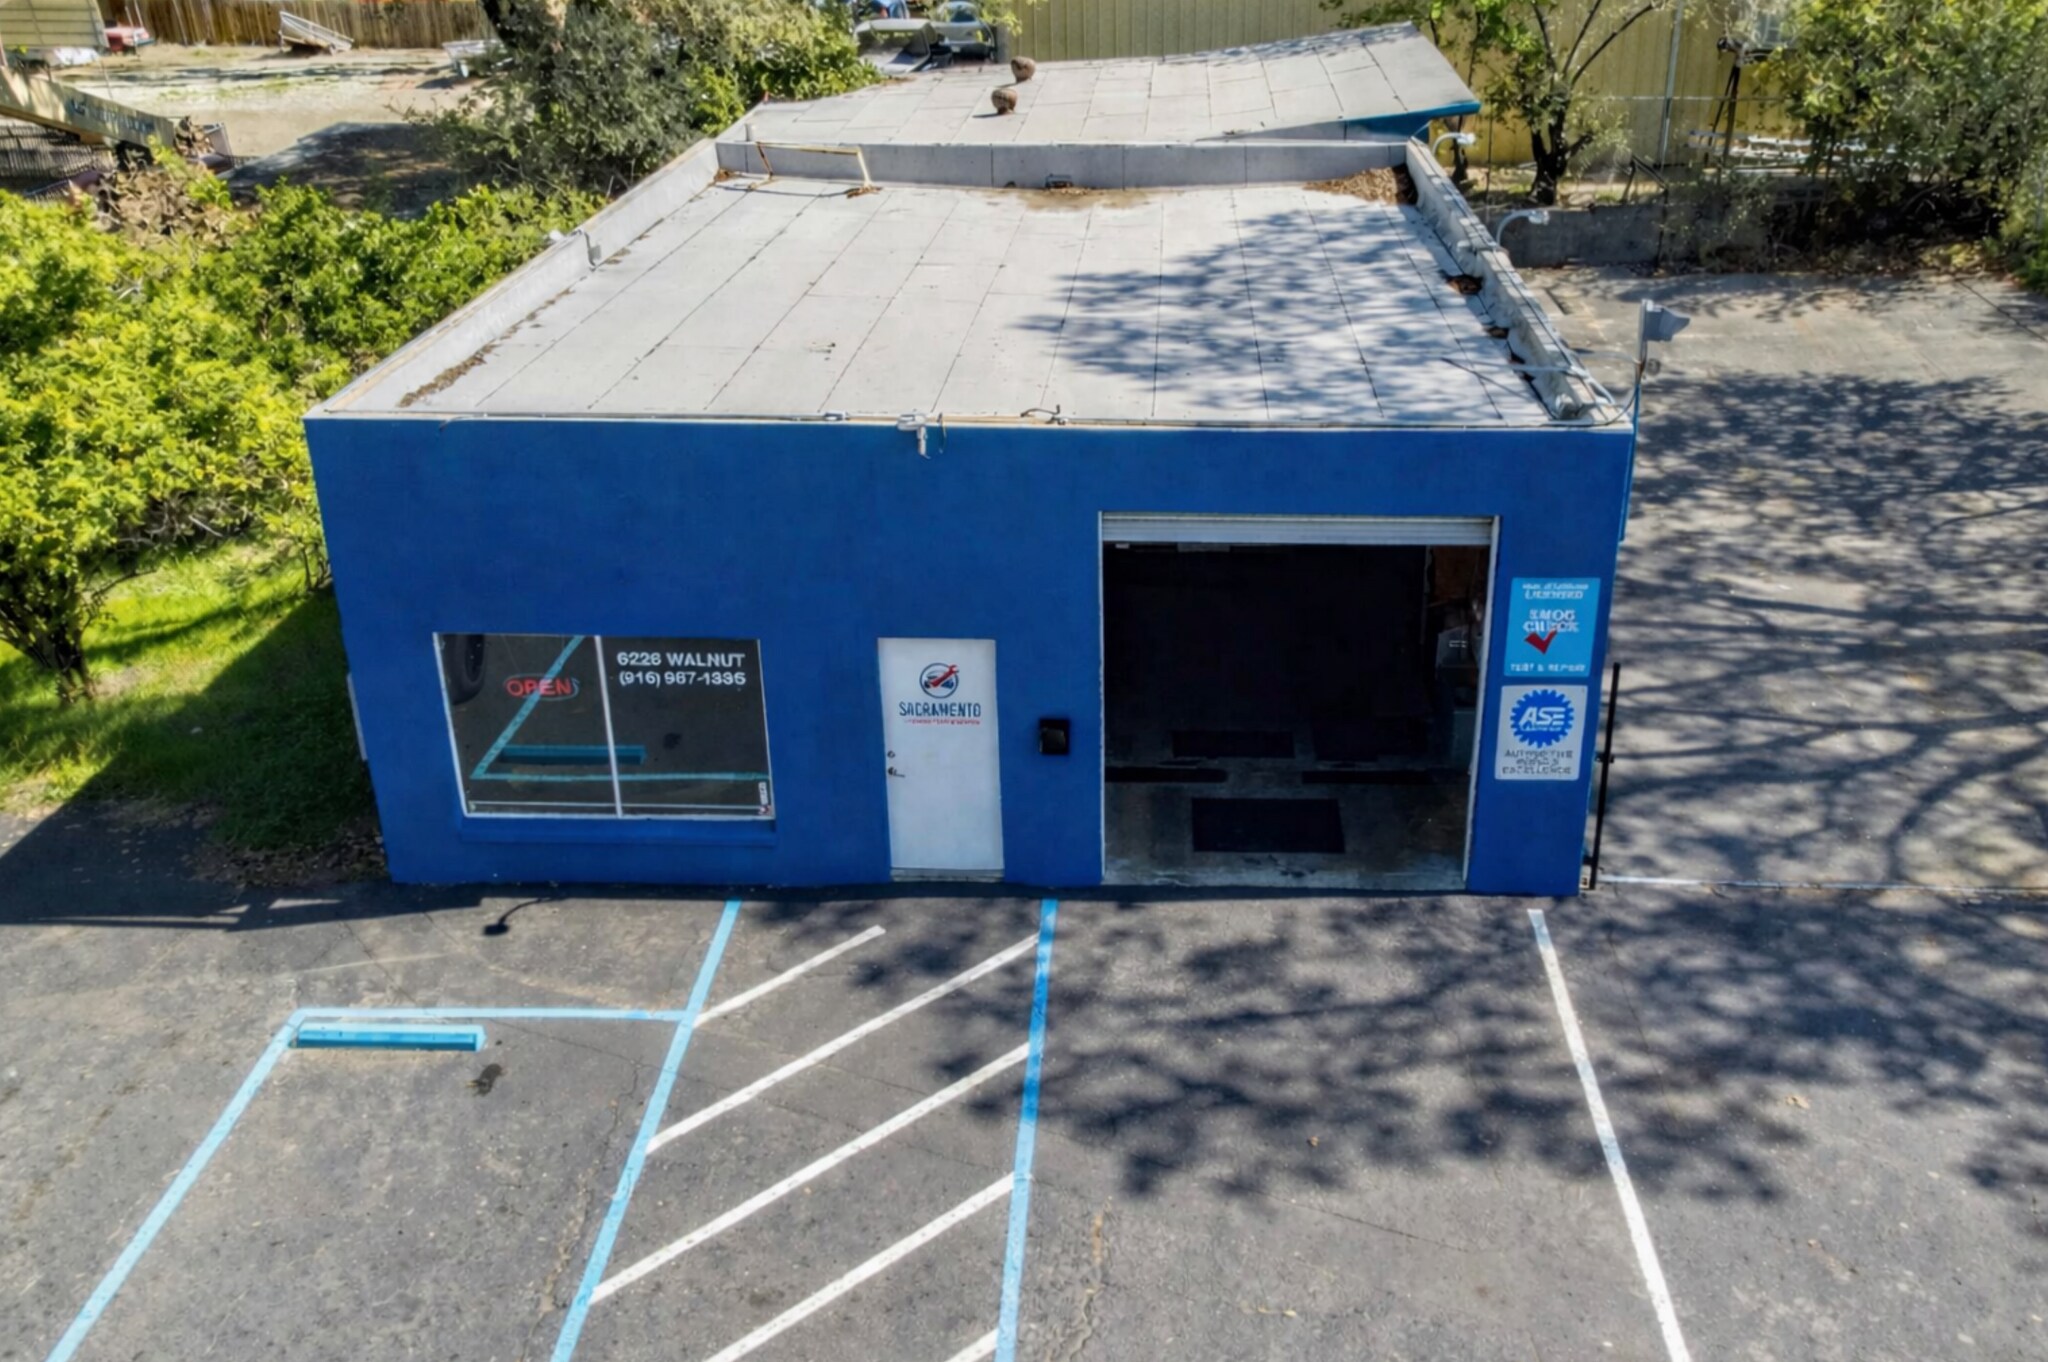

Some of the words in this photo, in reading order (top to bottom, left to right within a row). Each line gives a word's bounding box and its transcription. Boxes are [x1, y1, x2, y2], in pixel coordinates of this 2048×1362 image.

[1529, 609, 1576, 621] SMOG
[665, 651, 746, 667] WALNUT
[506, 678, 573, 697] OPEN
[619, 670, 661, 688] (916)
[898, 701, 982, 717] SACRAMENTO
[1518, 706, 1566, 727] ASE
